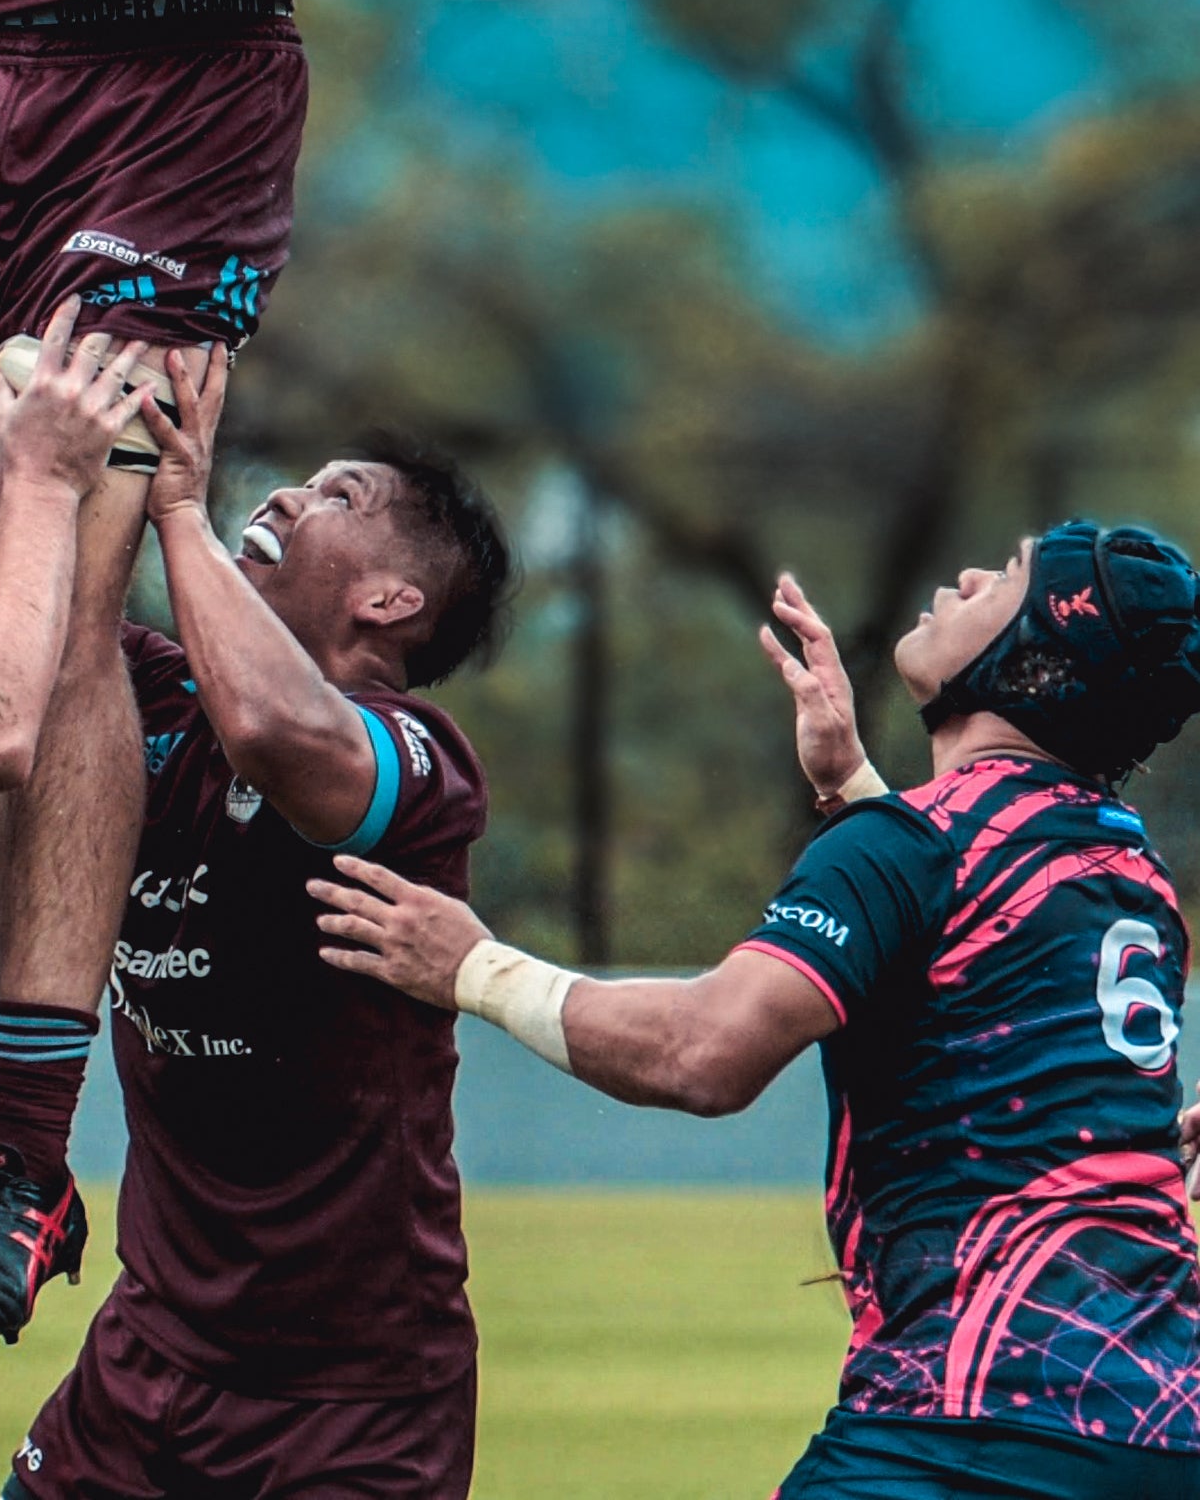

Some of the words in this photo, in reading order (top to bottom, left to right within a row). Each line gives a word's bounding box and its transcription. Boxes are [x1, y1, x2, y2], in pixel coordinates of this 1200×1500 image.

[78, 235, 140, 264] System
[143, 252, 187, 277] red
[1096, 919, 1180, 1070] 6
[201, 1033, 252, 1057] Inc.
